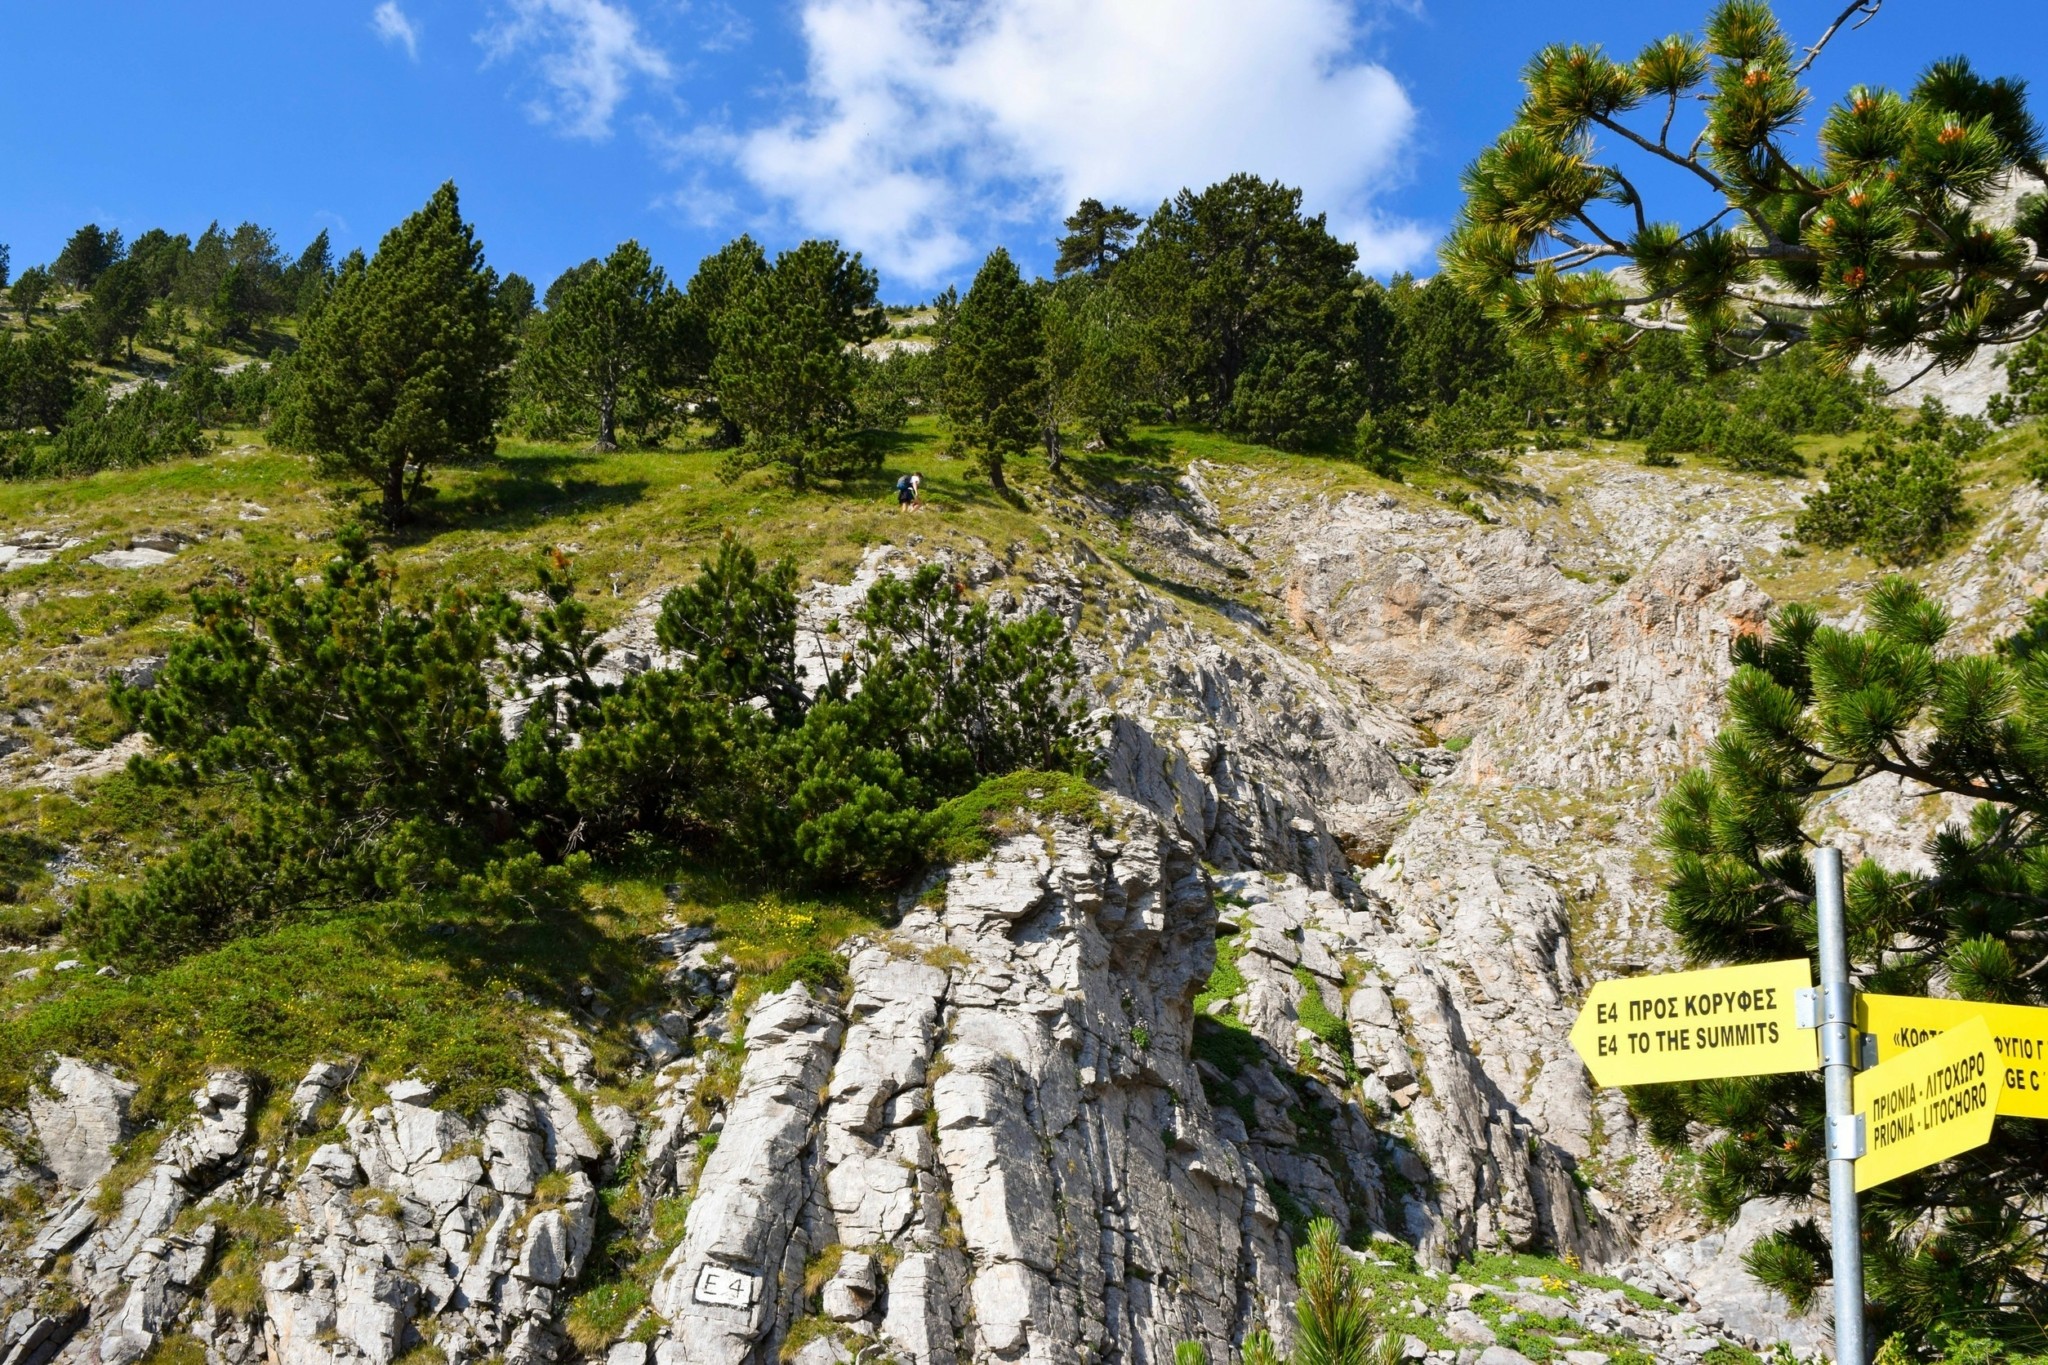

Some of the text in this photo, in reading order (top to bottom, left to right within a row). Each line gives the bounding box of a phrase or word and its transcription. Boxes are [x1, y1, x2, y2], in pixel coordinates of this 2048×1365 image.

[1597, 987, 1777, 1024] E4 ΠΡΟΣ ΚΟΡΥΦΕΣ
[1598, 1021, 1779, 1057] E4 TO THE SUMMITS
[1873, 1082, 1917, 1122] ΠΡΙΟΝΙΑ
[1926, 1051, 1985, 1100] ΛΙΤΟΧΩΡΟ
[1874, 1112, 1915, 1150] PRIONIA
[1923, 1082, 1987, 1131] LITOCHORO
